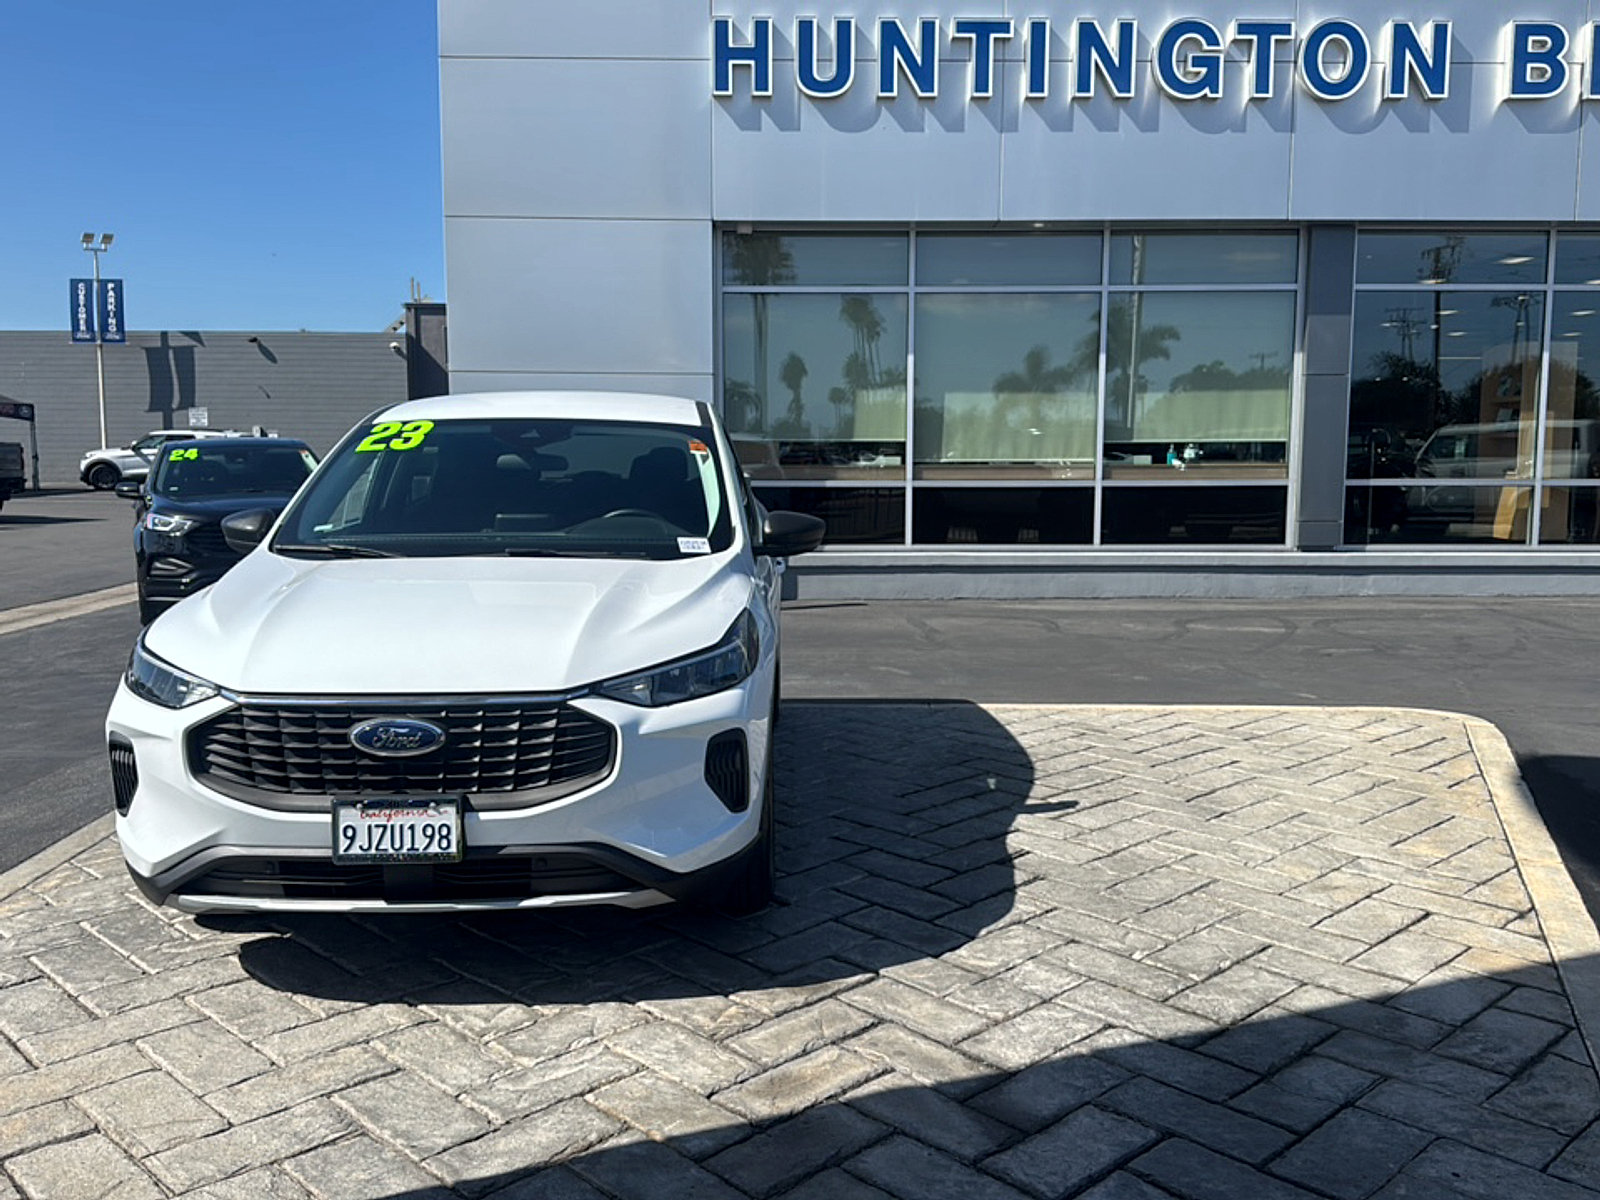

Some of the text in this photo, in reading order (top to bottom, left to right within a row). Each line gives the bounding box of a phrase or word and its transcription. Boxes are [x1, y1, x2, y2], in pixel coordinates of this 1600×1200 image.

[711, 16, 1600, 101] HUNTINGTON B
[77, 282, 87, 331] CUSTOMER
[106, 282, 117, 332] PARKING
[355, 420, 434, 453] 23
[169, 448, 199, 461] 24
[372, 727, 422, 749] Ford
[360, 808, 441, 822] California
[342, 823, 451, 853] 9JZU198
